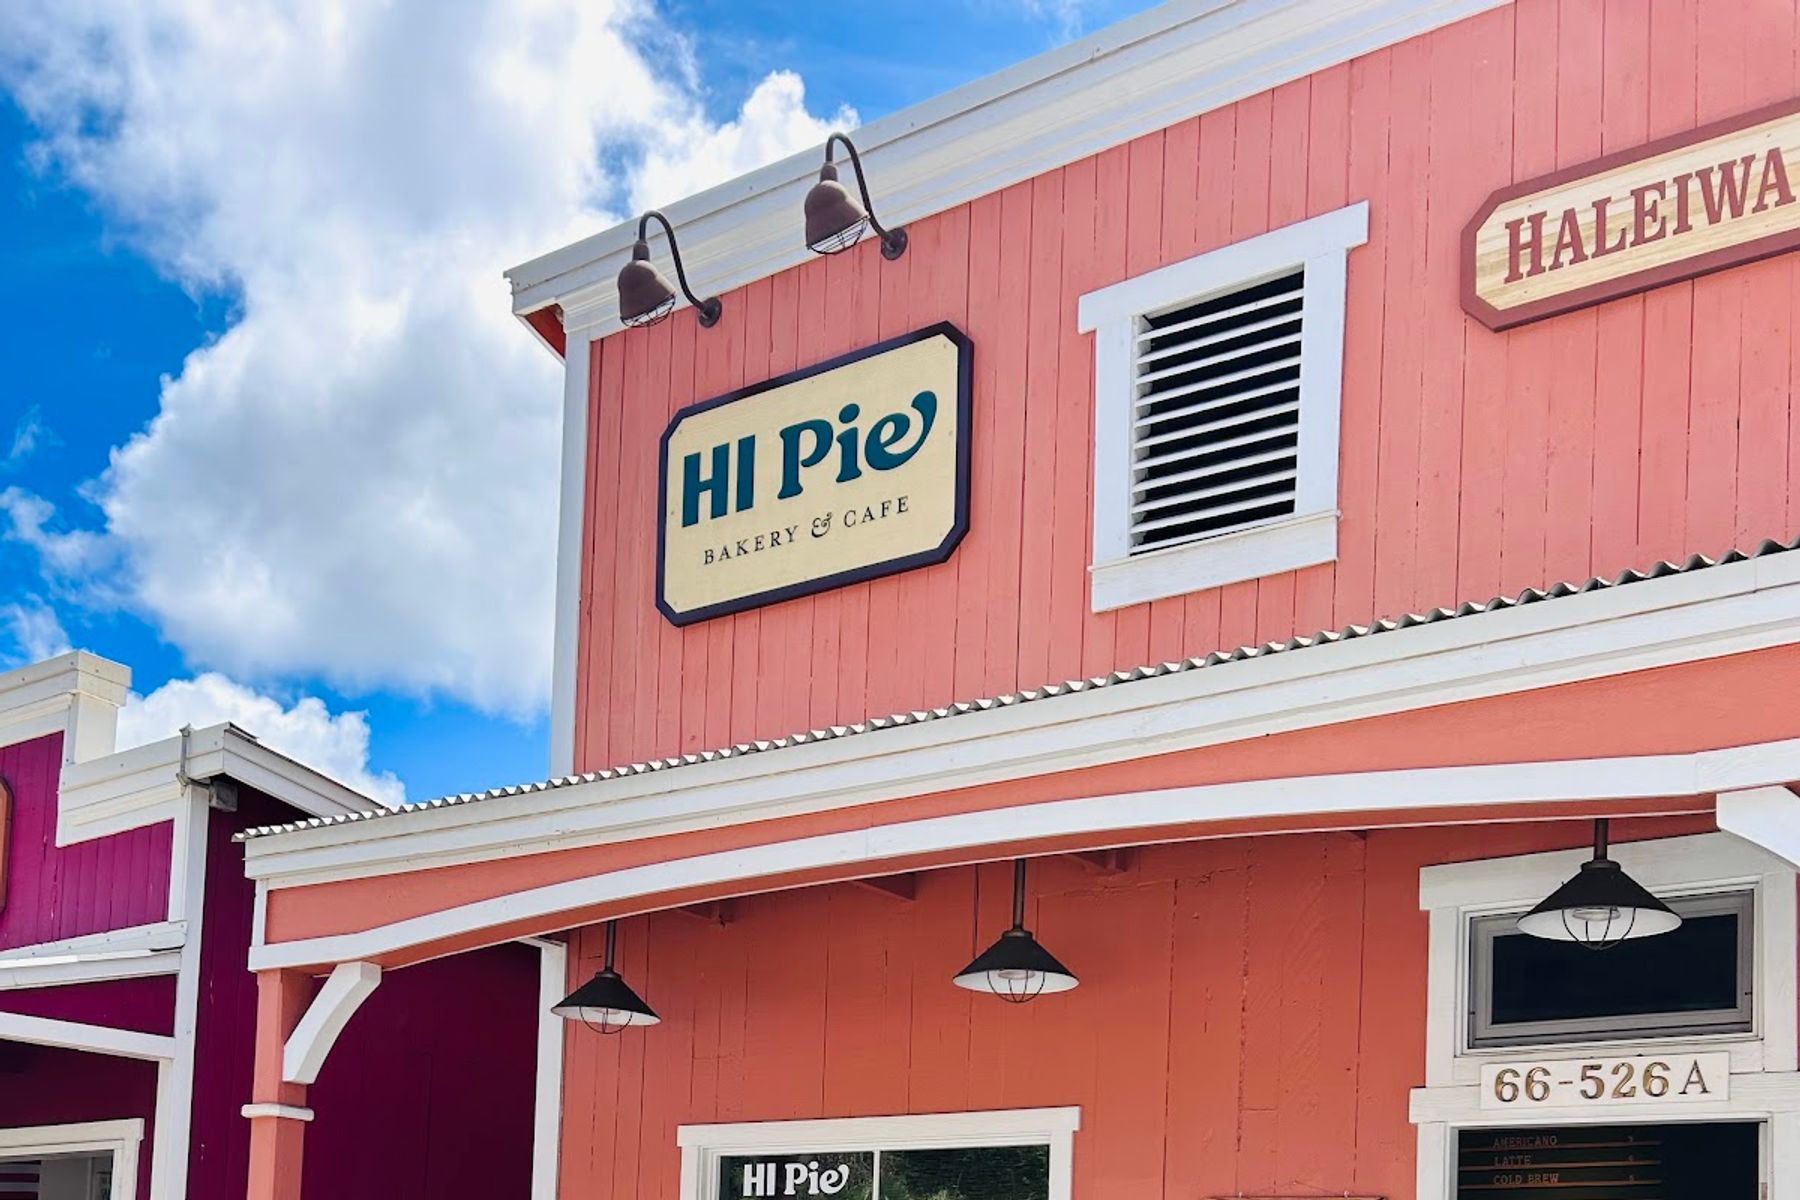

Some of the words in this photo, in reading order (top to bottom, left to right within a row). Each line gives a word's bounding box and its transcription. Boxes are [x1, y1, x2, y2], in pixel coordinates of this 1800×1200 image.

[1504, 147, 1797, 284] HALEIWA
[681, 434, 756, 528] HI
[777, 390, 937, 500] Pie
[703, 525, 798, 565] BAKERY
[811, 512, 832, 538] &
[843, 495, 909, 527] CAFE
[1493, 1136, 1557, 1148] AMERICANO
[1494, 1155, 1532, 1166] LATTE
[743, 1163, 776, 1197] HI
[784, 1161, 850, 1196] Pie
[1493, 1175, 1522, 1185] COLD
[1528, 1173, 1559, 1184] BREW
